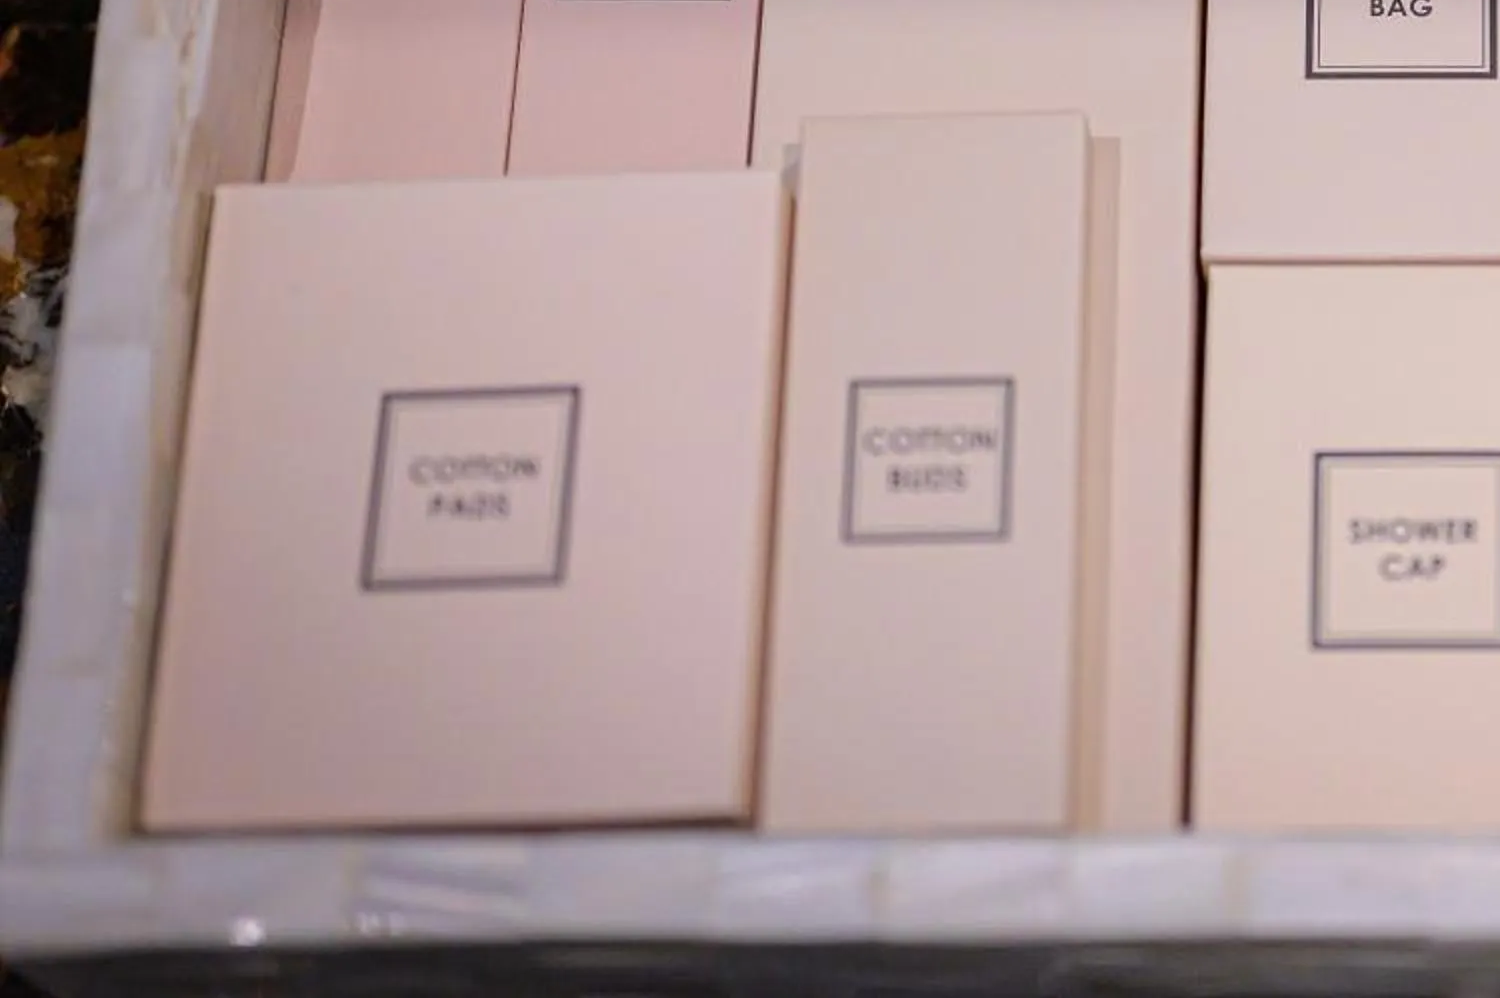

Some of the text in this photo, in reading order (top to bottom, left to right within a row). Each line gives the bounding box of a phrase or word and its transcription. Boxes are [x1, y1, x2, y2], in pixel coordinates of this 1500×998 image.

[860, 425, 999, 456] COTTON
[408, 454, 541, 487] COTTON
[885, 463, 970, 494] BUDS
[1349, 517, 1479, 545] SHOWER
[1376, 552, 1447, 582] CAP
